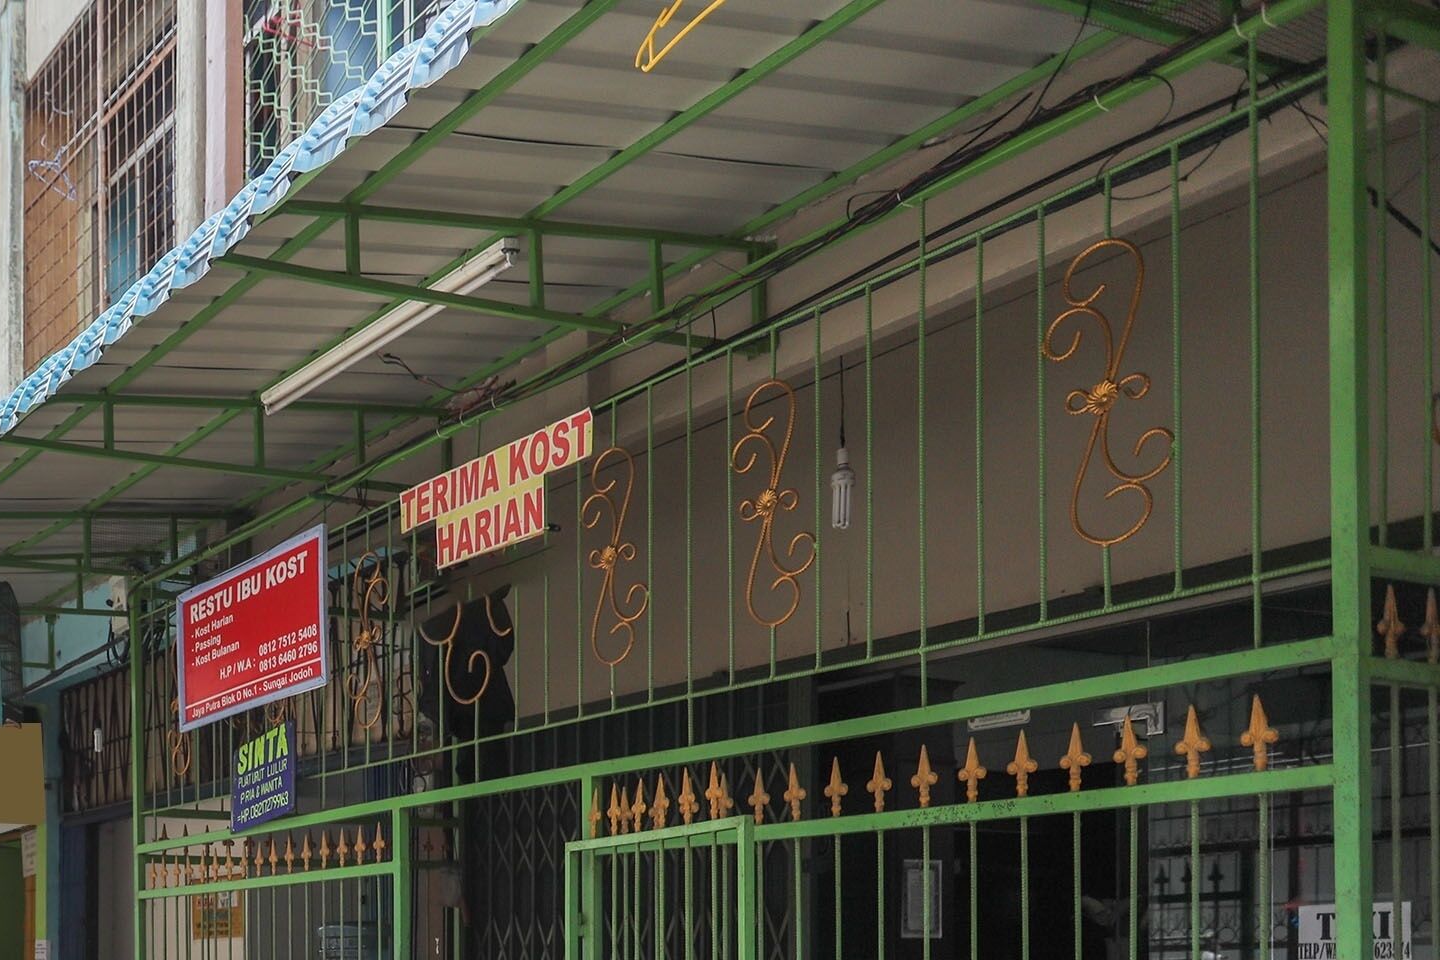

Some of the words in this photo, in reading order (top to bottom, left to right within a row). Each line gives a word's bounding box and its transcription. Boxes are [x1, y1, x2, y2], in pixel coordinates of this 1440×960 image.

[402, 454, 499, 529] TERIMA
[510, 410, 591, 486] KOST
[437, 488, 543, 566] HARIAN
[190, 585, 233, 624] RESTU
[237, 572, 262, 603] IBU
[266, 550, 308, 590] KOST
[195, 623, 210, 638] Kost
[211, 614, 234, 631] Harian
[258, 639, 277, 656] 0812
[278, 631, 296, 649] 7512
[298, 623, 318, 641] 5408
[195, 634, 222, 653] Passing
[195, 652, 211, 667] Kost
[211, 641, 240, 660] Bulanan
[259, 656, 277, 672] 0813
[278, 648, 297, 665] 6460
[298, 640, 318, 658] 2796
[263, 674, 288, 691] Sungai
[288, 666, 313, 683] Jodoh
[237, 723, 289, 775] SINTA
[1317, 911, 1391, 940] TI
